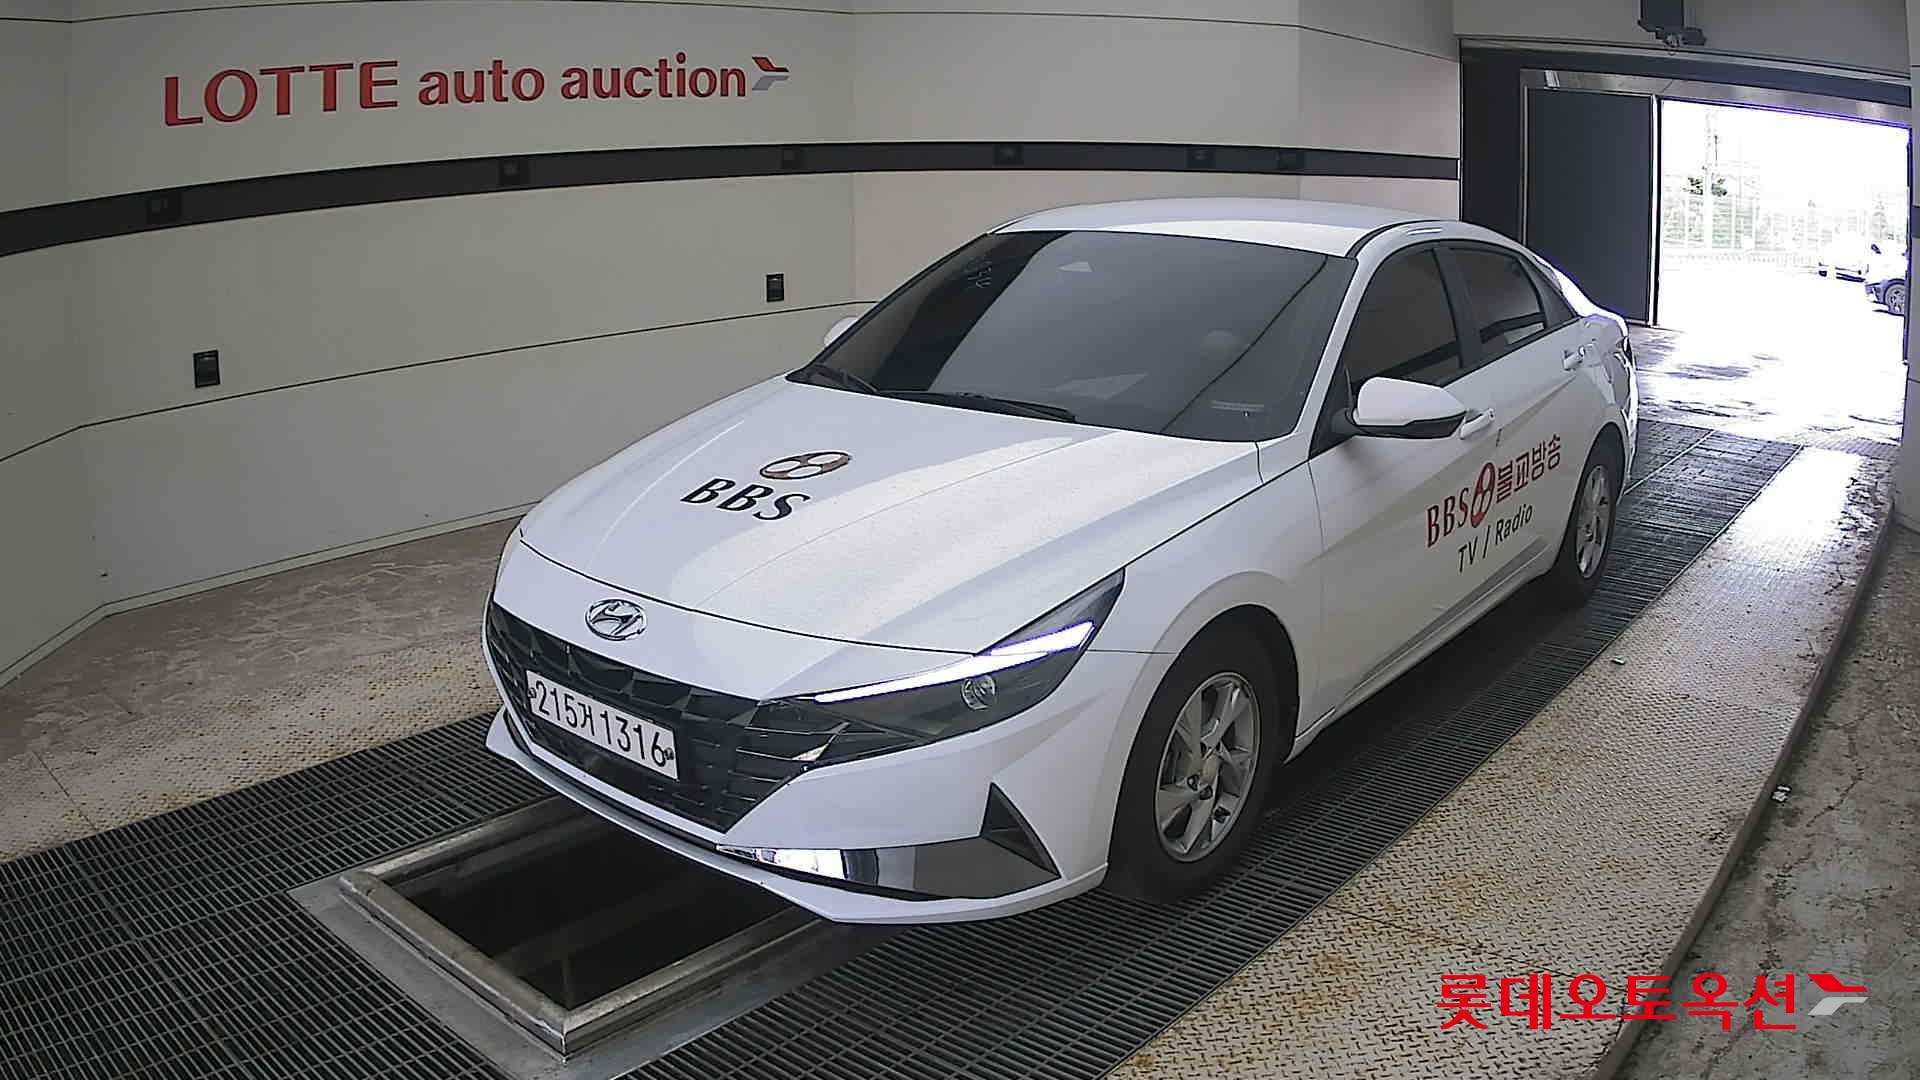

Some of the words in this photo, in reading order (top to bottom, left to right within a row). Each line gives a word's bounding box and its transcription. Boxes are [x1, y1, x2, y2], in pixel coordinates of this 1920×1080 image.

[164, 60, 399, 127] LOTTE
[418, 59, 545, 105] auto
[561, 52, 747, 99] auction
[680, 478, 811, 520] BBS
[1427, 487, 1469, 548] BBS
[1496, 433, 1561, 504] 불교방송
[1458, 536, 1478, 573] TV
[1495, 503, 1533, 545] Radio
